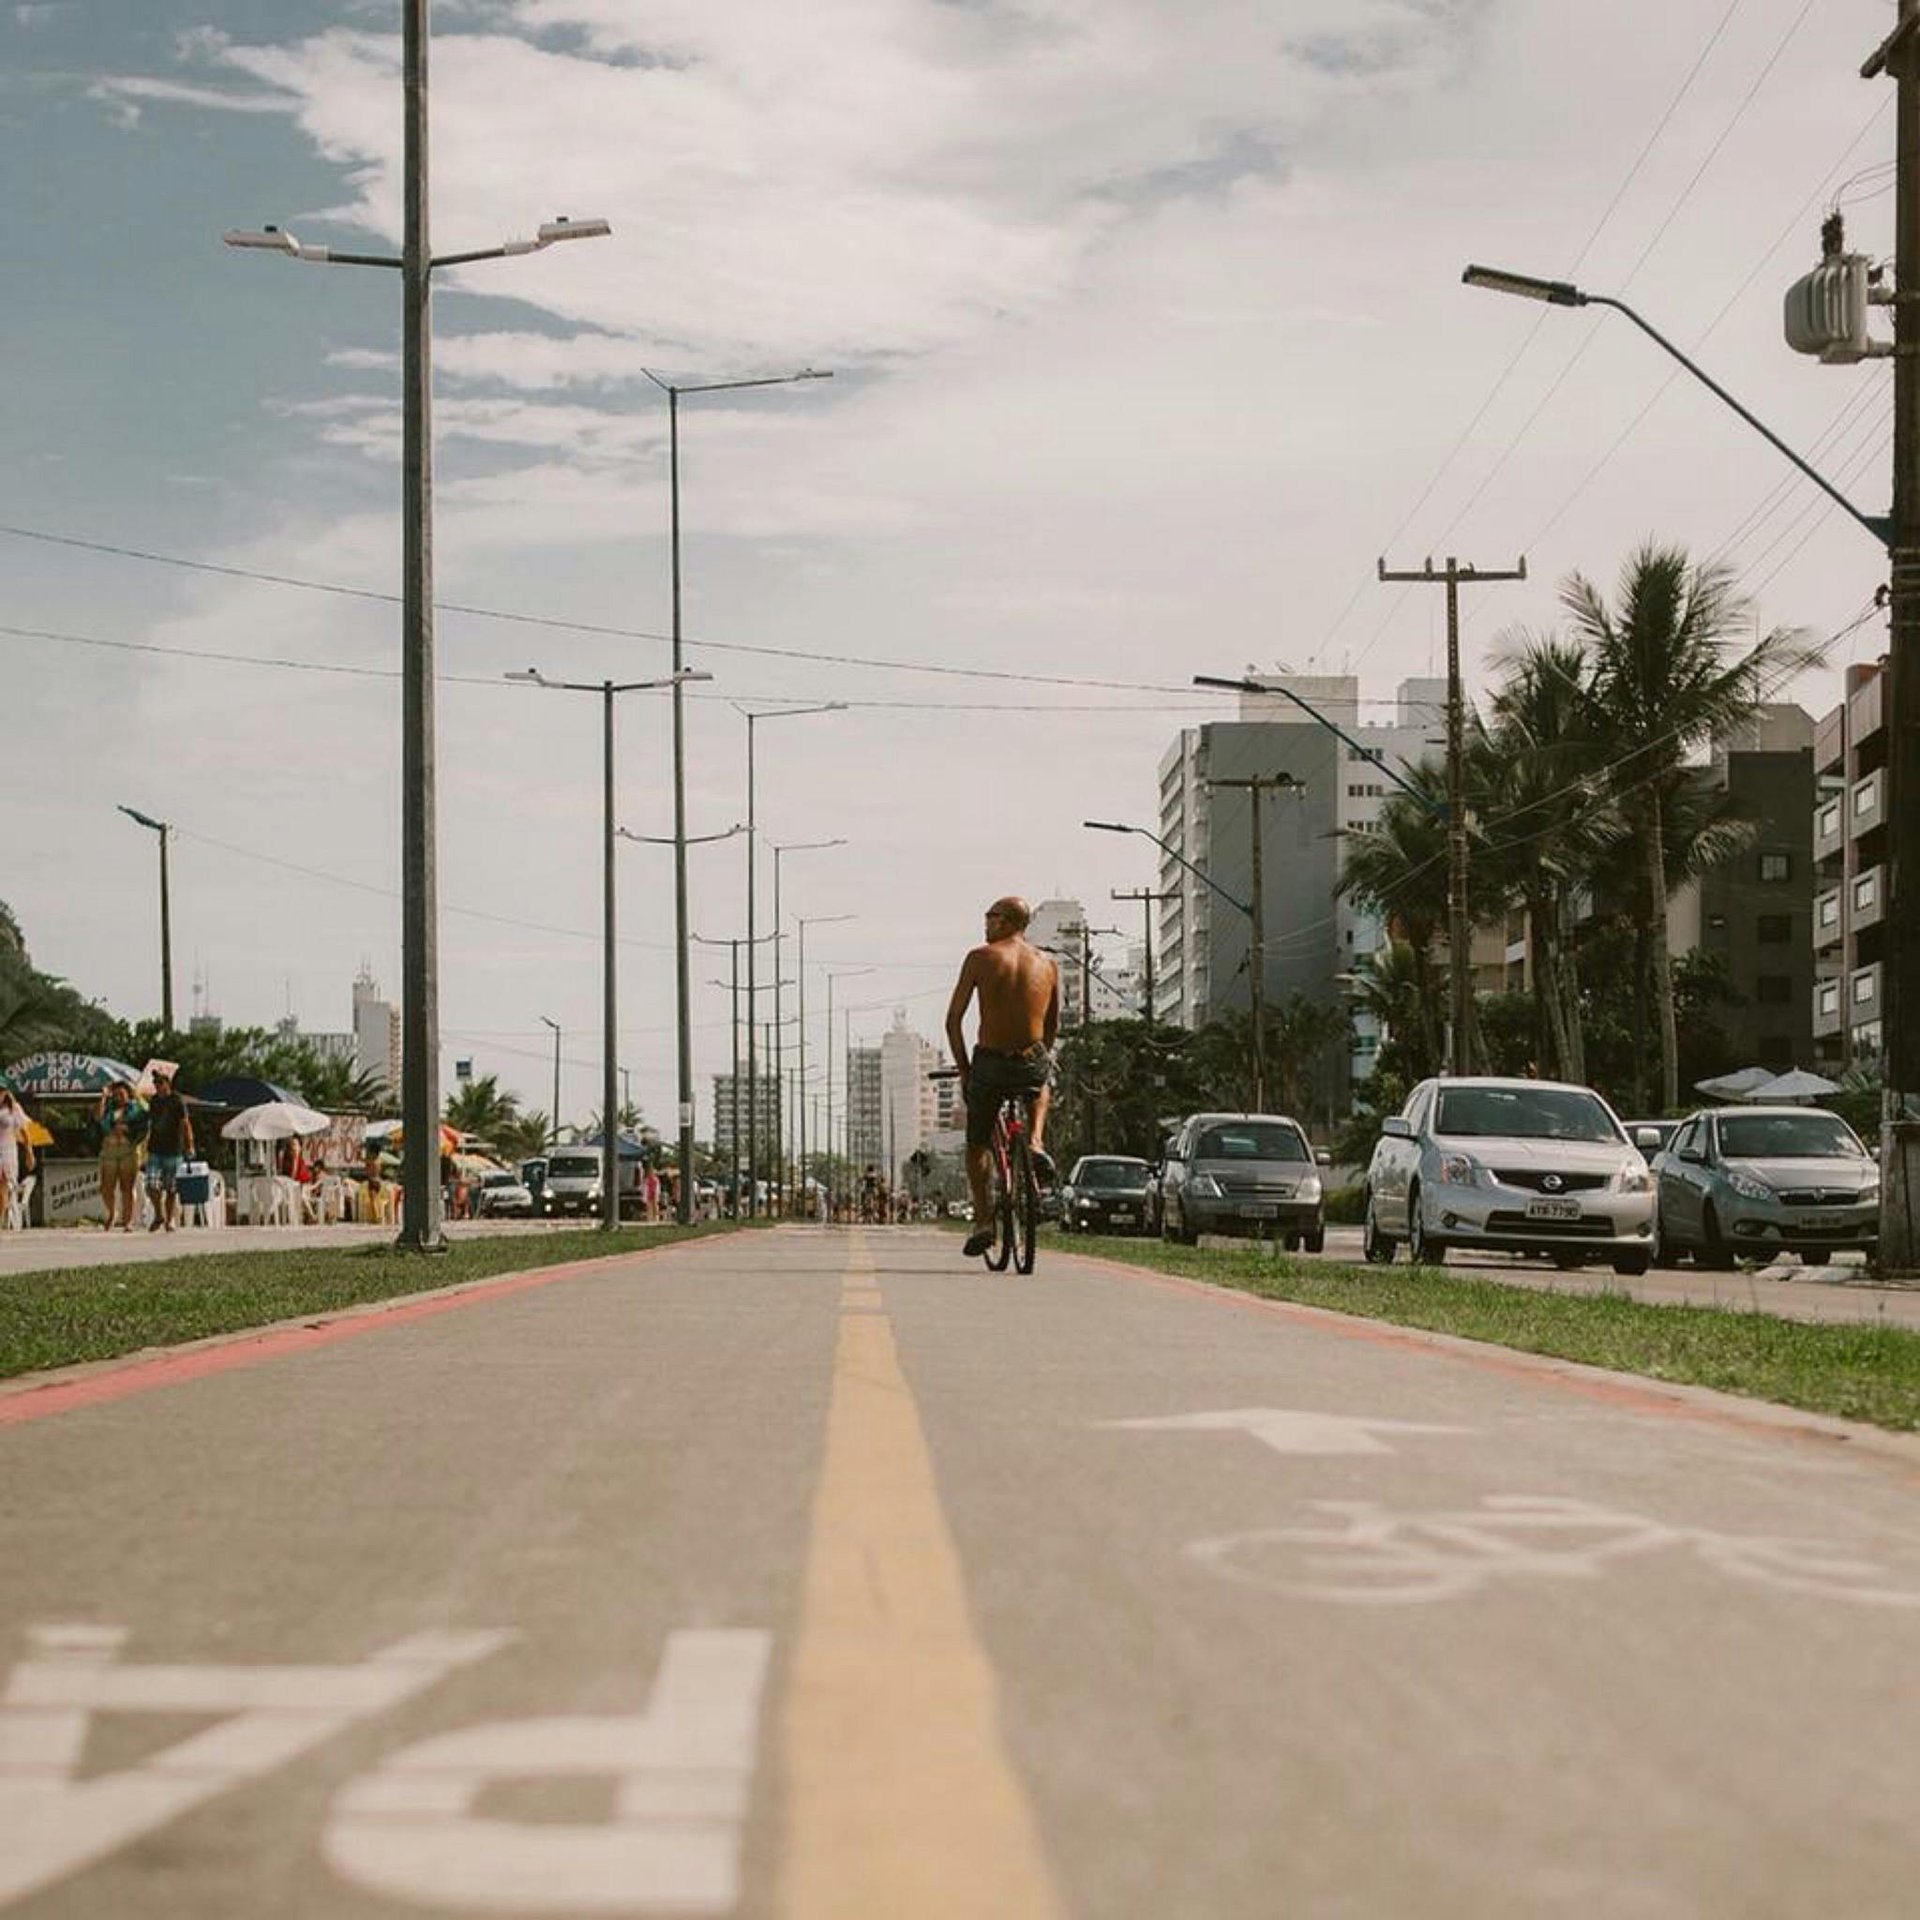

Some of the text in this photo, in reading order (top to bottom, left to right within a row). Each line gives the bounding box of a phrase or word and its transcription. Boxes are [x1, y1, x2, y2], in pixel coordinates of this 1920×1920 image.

[5, 1052, 97, 1079] QUIOSQUE
[47, 1066, 69, 1078] DO
[16, 1079, 84, 1092] VIEIRA
